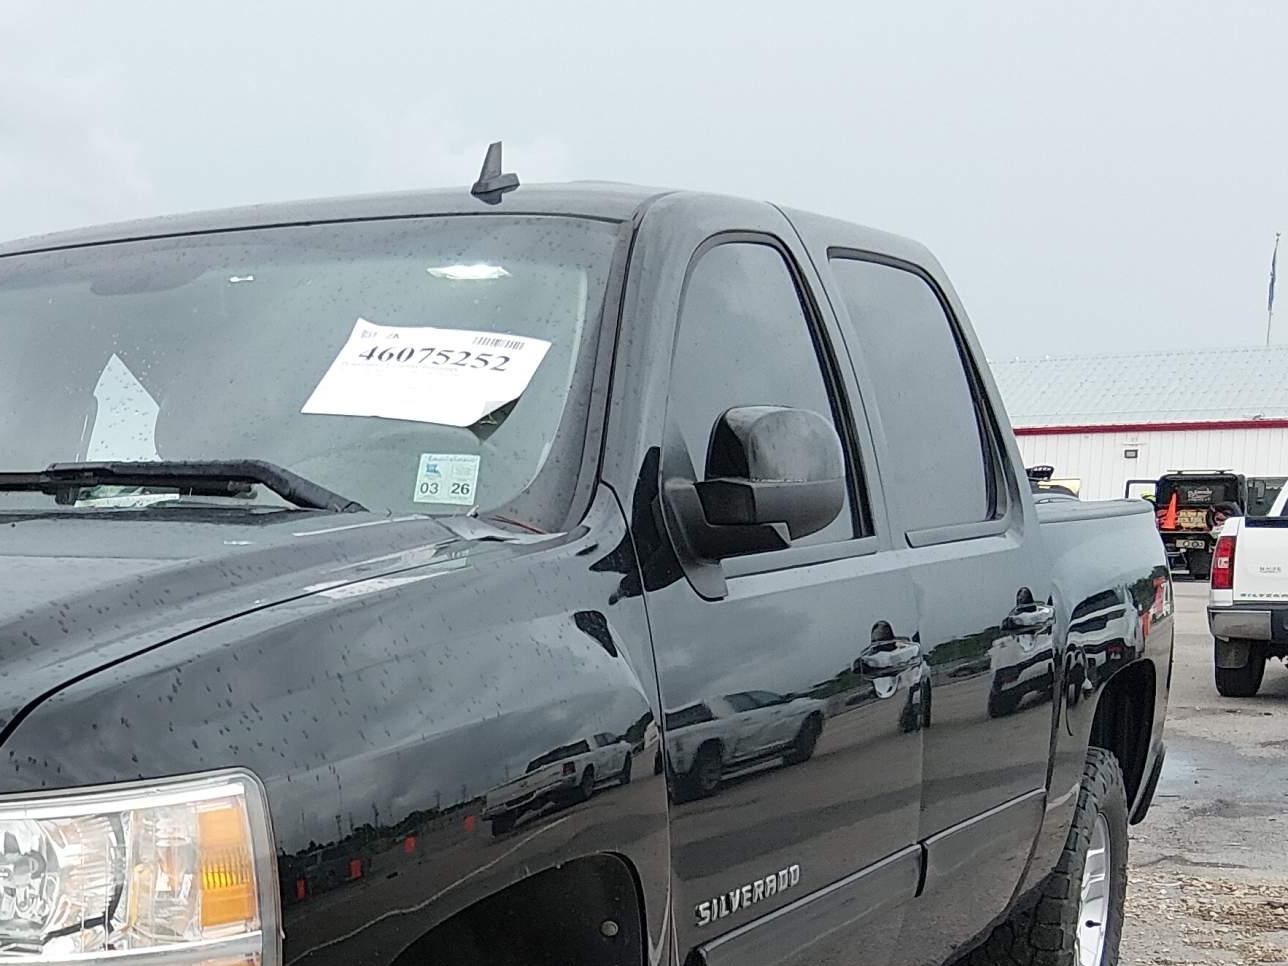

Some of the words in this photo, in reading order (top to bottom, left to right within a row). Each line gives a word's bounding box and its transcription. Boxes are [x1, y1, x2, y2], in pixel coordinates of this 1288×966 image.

[358, 345, 511, 372] 46075252
[420, 482, 439, 494] 03
[451, 482, 470, 495] 26
[695, 864, 801, 926] SILVERADO
